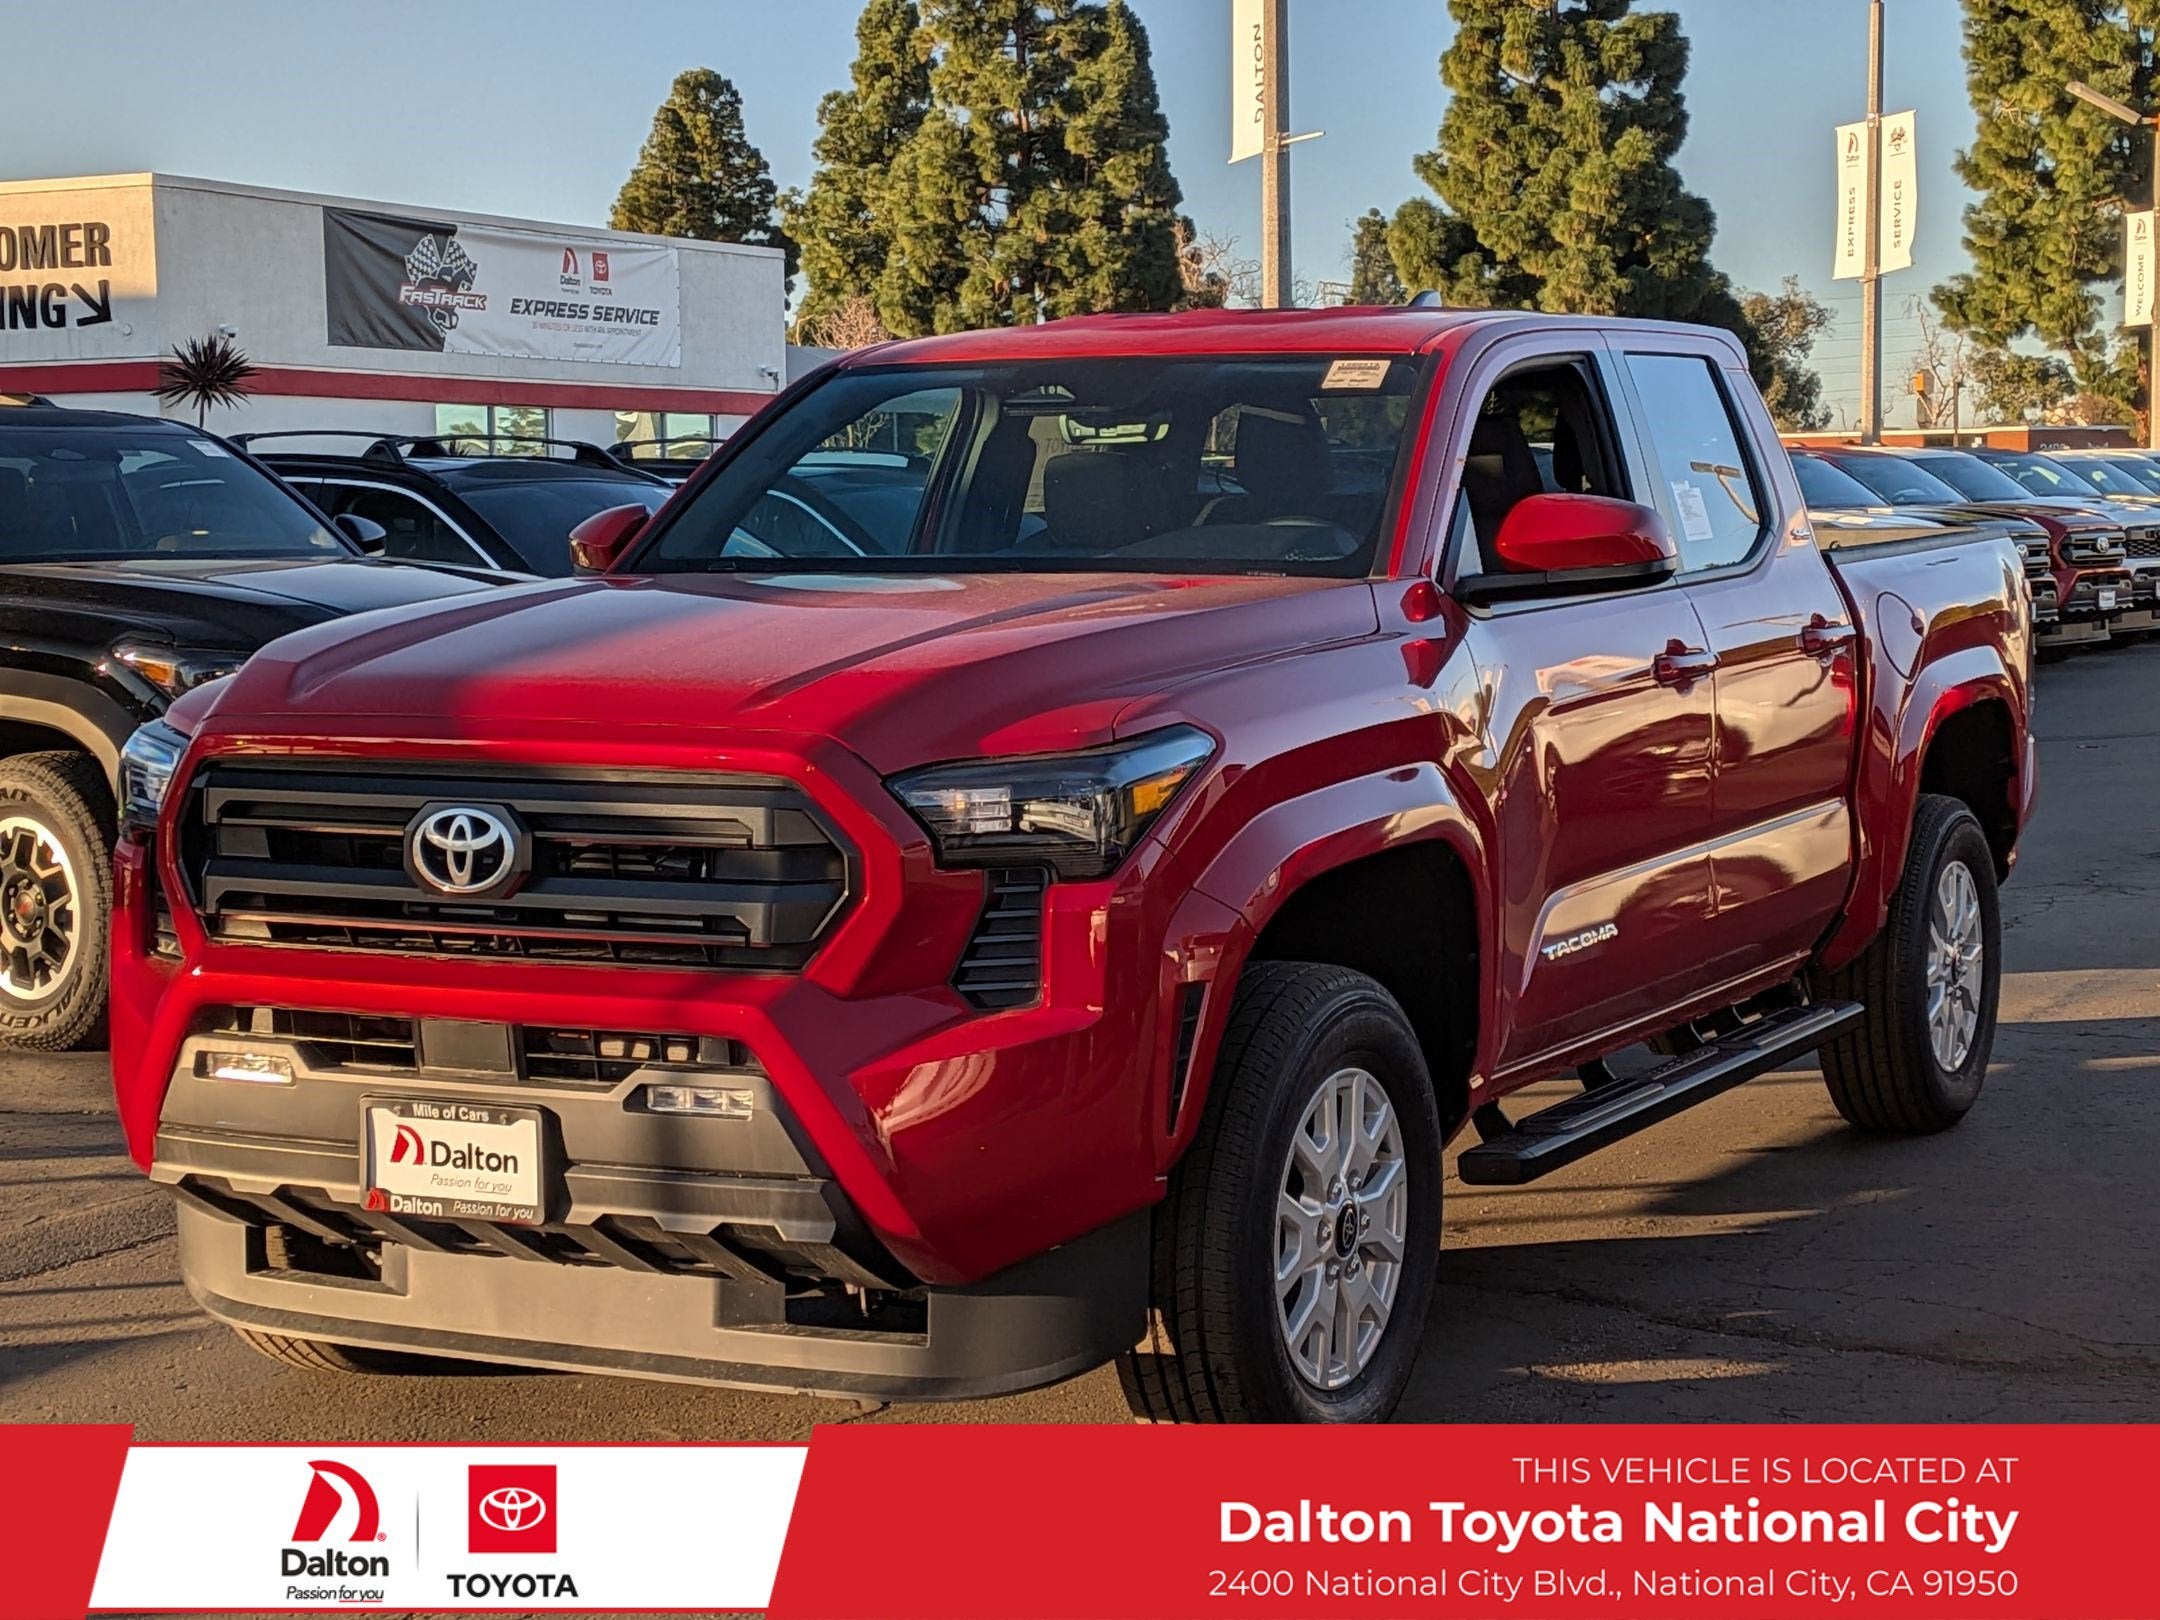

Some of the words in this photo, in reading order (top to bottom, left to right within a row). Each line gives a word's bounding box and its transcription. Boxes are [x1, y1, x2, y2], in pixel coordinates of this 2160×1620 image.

[1847, 187, 1856, 257] EXPRESS
[1893, 180, 1902, 249] SERVICE
[2135, 254, 2145, 317] WELCOME
[510, 298, 590, 320] EXPRESS
[592, 305, 660, 326] SERVICE
[1541, 923, 1619, 960] TACOMA
[412, 1103, 440, 1119] Mile
[442, 1105, 457, 1120] of
[459, 1106, 490, 1122] Cars
[431, 1140, 518, 1174] Dalton
[430, 1173, 472, 1189] Passion
[474, 1176, 490, 1192] for
[491, 1182, 513, 1195] you
[390, 1194, 443, 1216] Dalton
[453, 1200, 494, 1216] Passion
[495, 1204, 512, 1217] for
[512, 1207, 534, 1221] you
